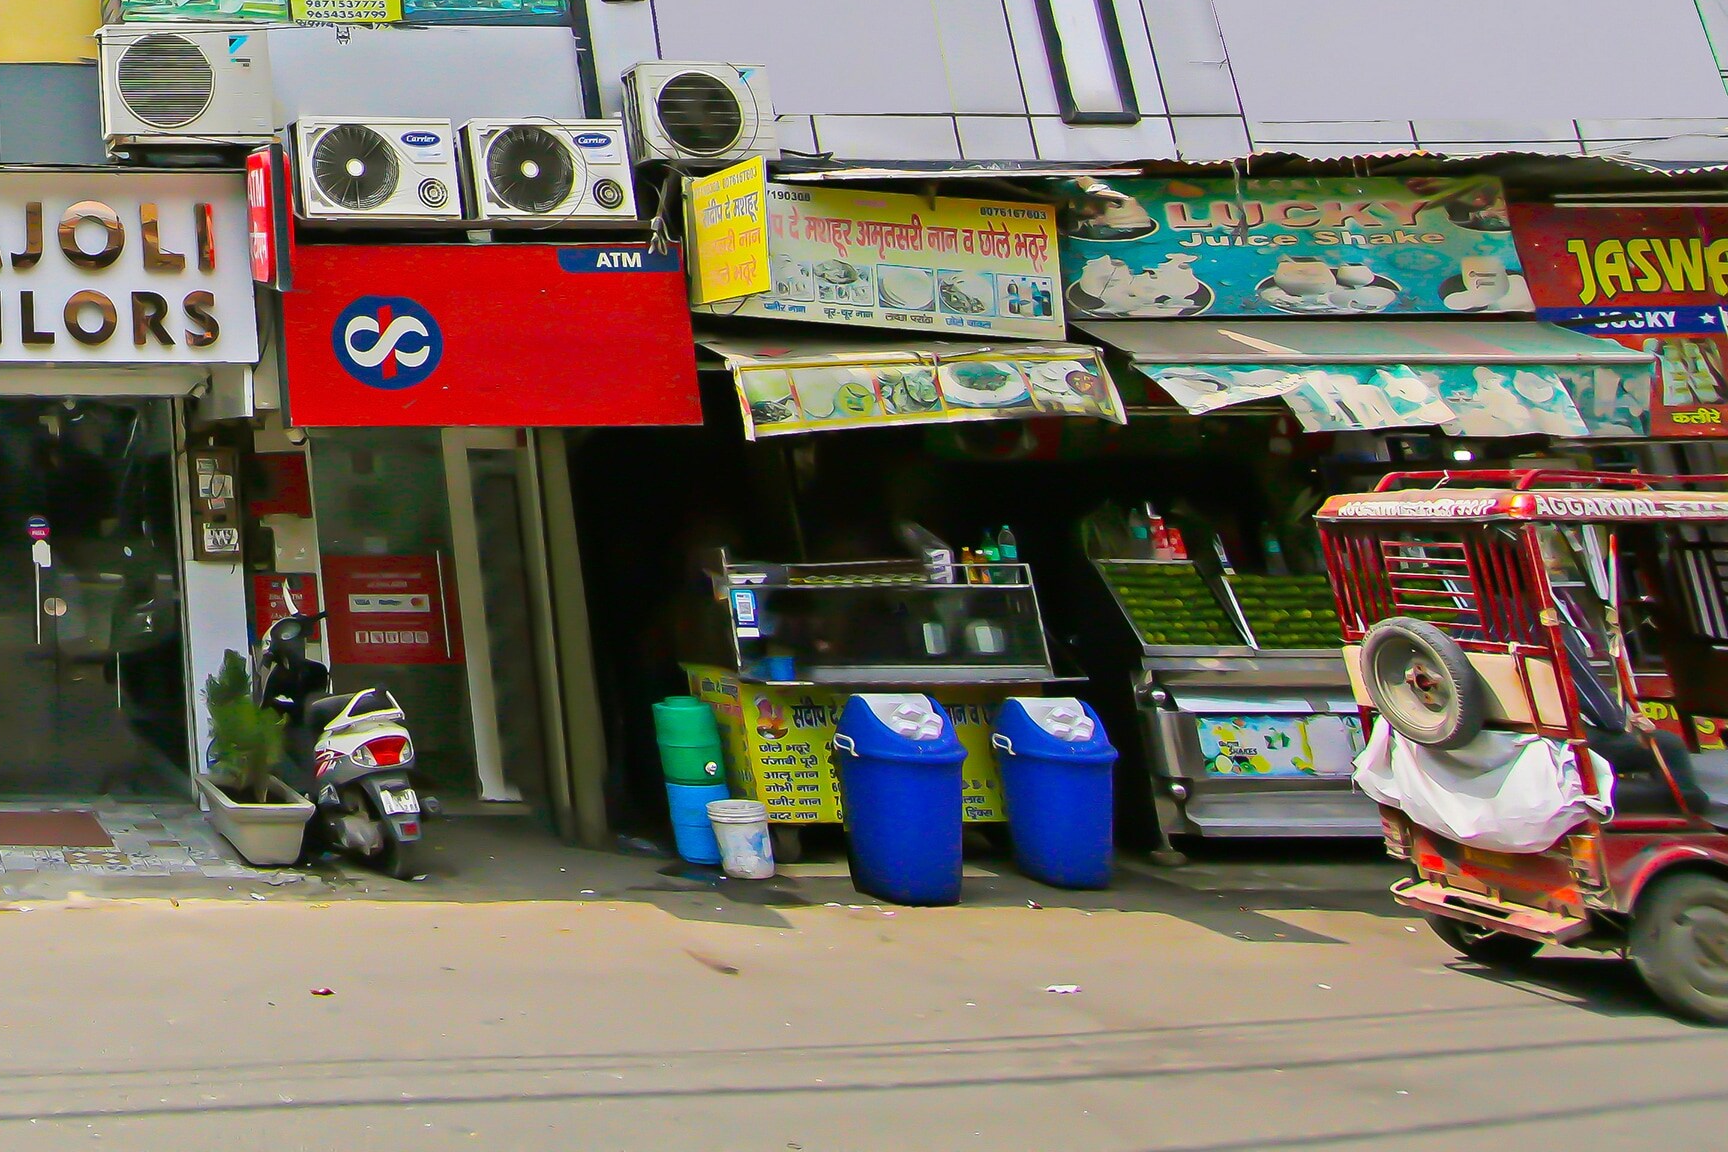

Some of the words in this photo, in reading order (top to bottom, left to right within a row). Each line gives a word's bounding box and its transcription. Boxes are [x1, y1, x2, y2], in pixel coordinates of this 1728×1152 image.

[305, 0, 385, 8] 9871537775
[406, 135, 436, 144] Carrier
[577, 136, 607, 145] Carrier
[248, 168, 265, 208] ATM
[1166, 199, 1430, 229] LUCKY
[927, 226, 959, 254] नान
[1178, 230, 1299, 248] Juice
[1314, 230, 1446, 246] Shake
[596, 252, 642, 268] ATM
